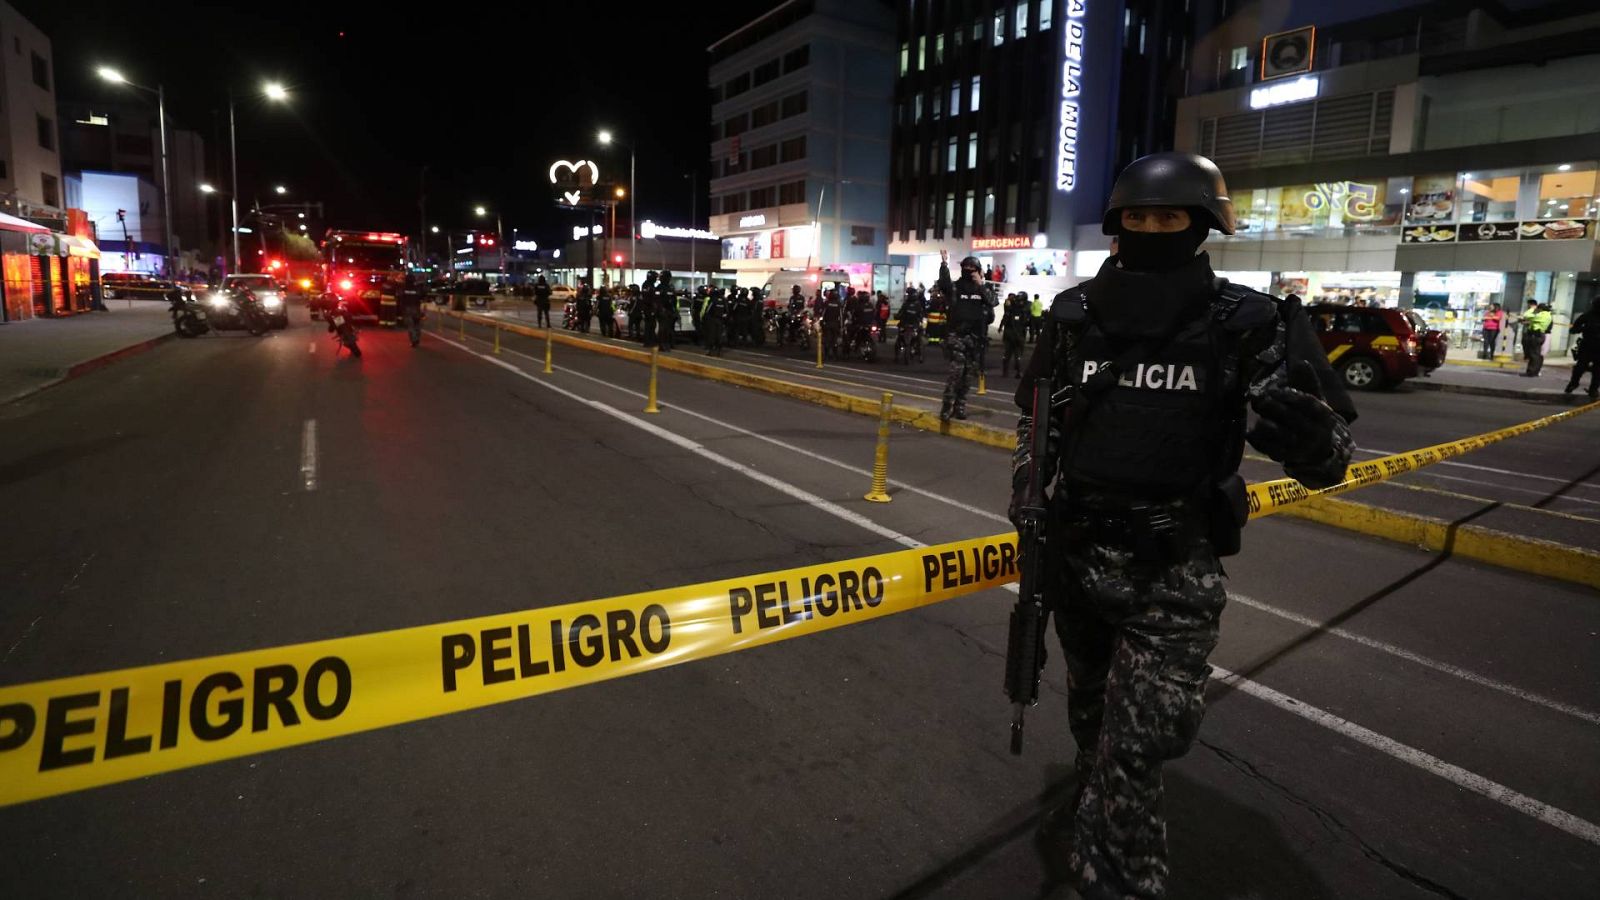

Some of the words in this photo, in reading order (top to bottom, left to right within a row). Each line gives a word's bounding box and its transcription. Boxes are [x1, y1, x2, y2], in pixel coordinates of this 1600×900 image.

[1068, 22, 1083, 58] DE
[1066, 63, 1081, 95] LA
[1060, 103, 1079, 189] MUJER
[972, 237, 1031, 249] EMERGENCIA
[1082, 360, 1198, 390] PLICIA
[922, 542, 1021, 593] PELIGR
[728, 566, 885, 635] PELIGRO
[441, 603, 671, 693] PELIGRO
[0, 656, 352, 773] PELIGRO
